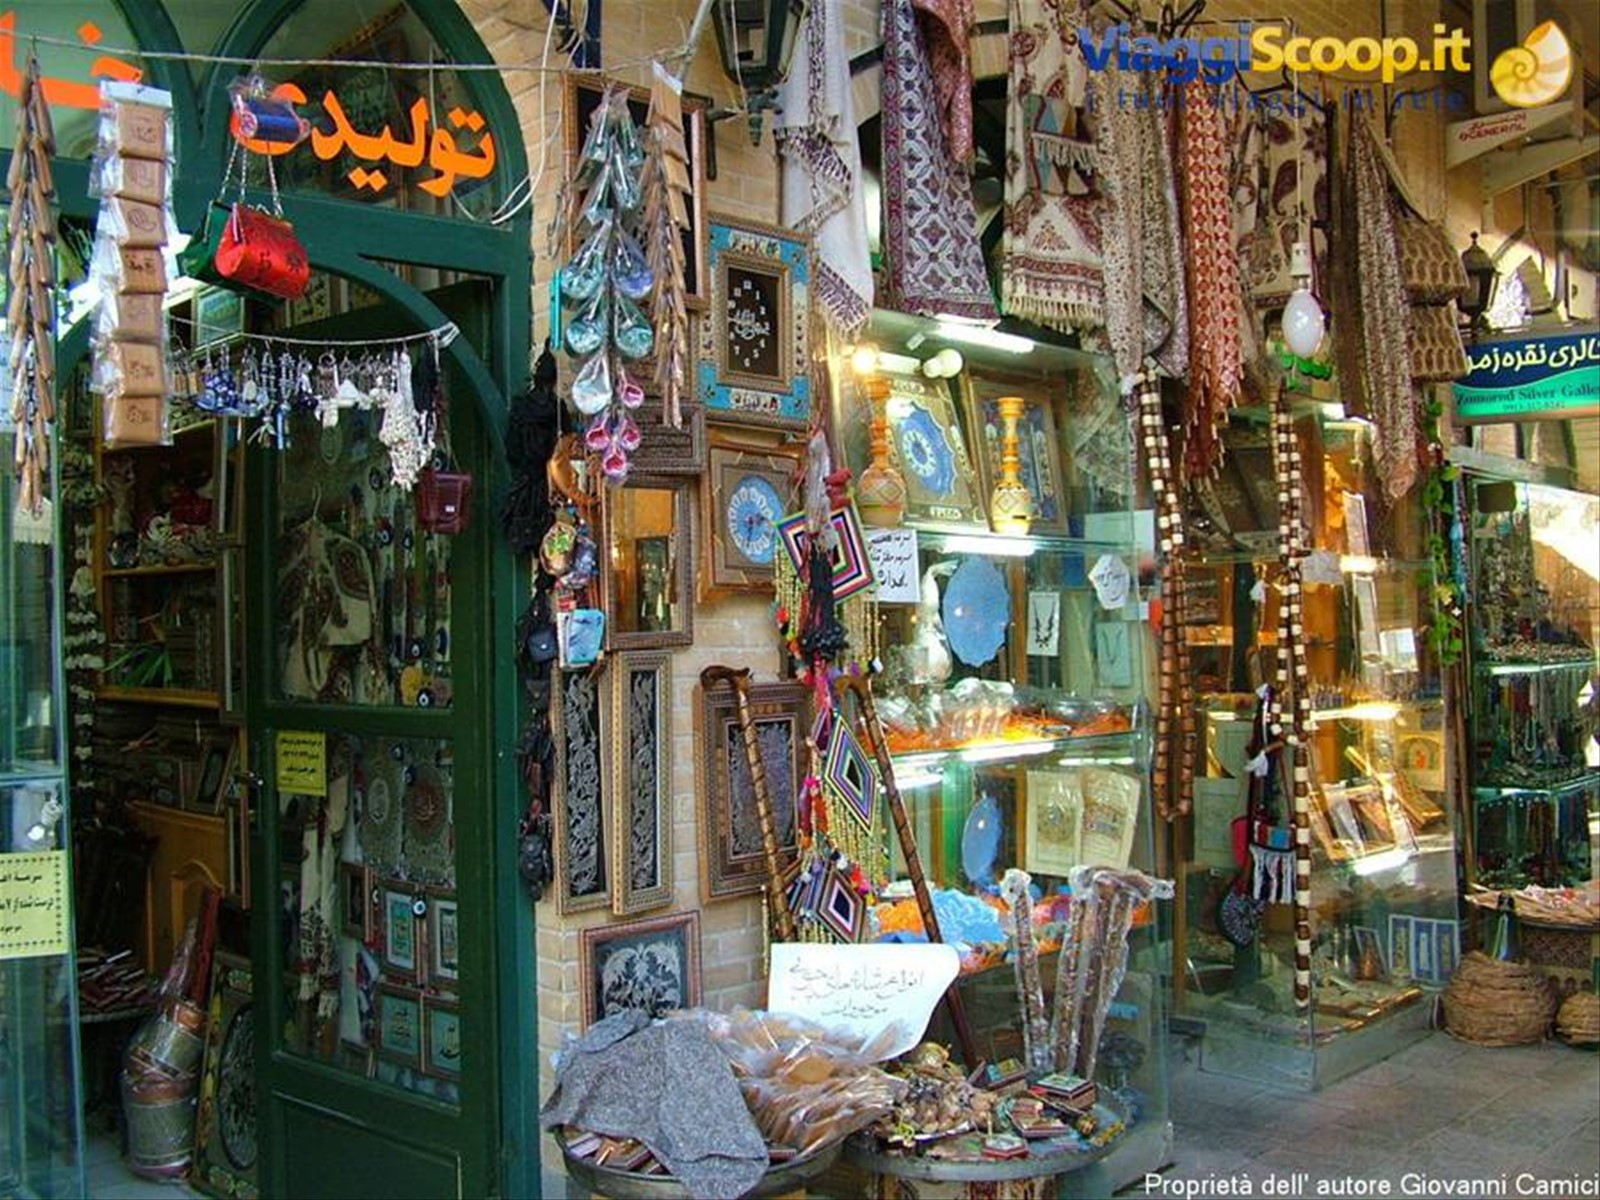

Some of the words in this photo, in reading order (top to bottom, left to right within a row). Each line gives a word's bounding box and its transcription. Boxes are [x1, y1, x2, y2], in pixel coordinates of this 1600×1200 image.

[230, 82, 497, 198] تولیدی
[1501, 343, 1547, 372] نقره
[1519, 386, 1556, 400] Silver
